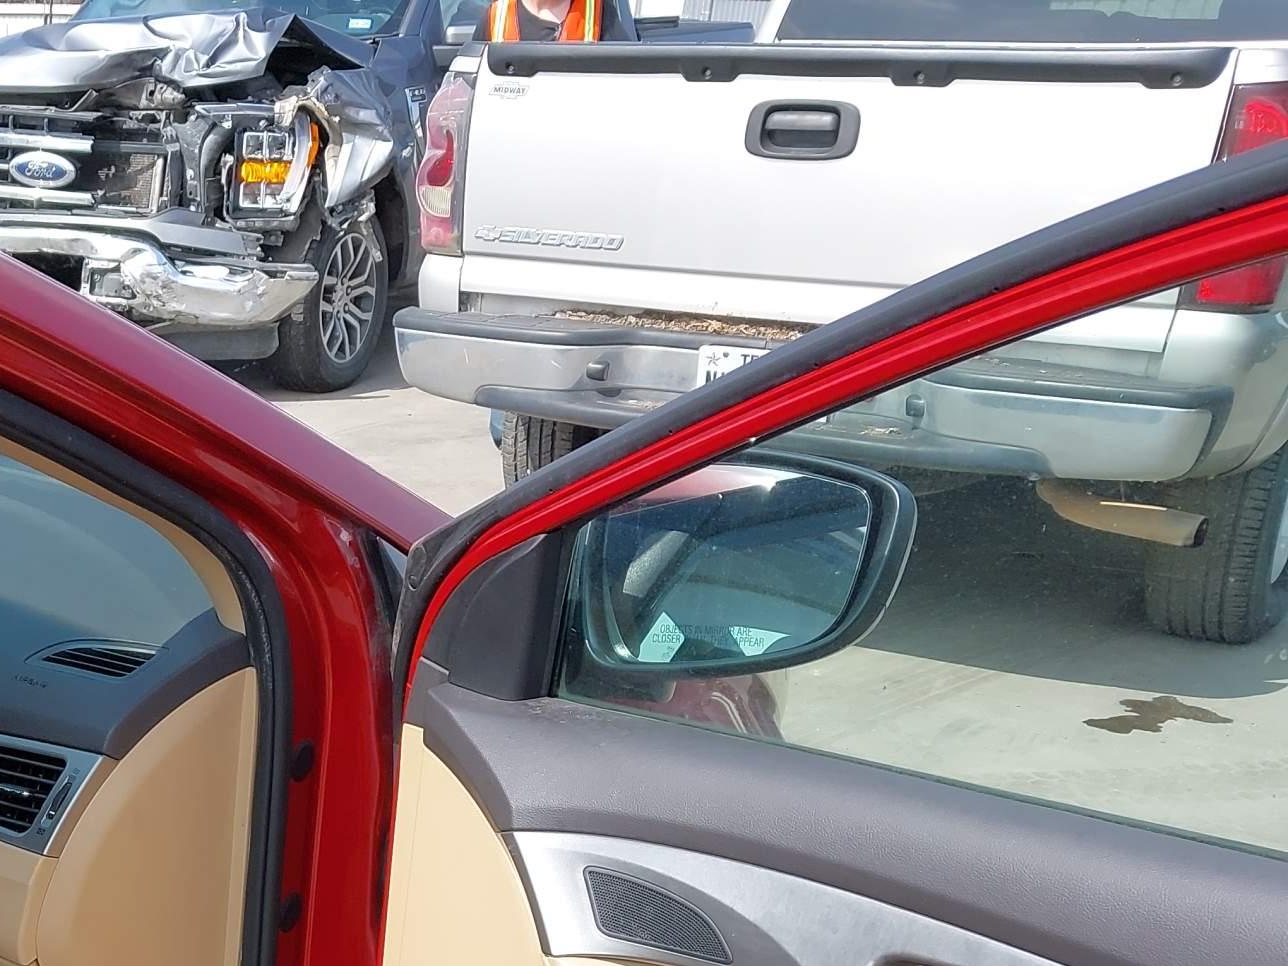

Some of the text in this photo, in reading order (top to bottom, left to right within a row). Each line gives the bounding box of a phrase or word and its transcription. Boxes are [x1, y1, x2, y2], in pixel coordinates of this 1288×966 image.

[492, 86, 527, 95] MIDWAY
[25, 160, 56, 178] Ford
[498, 227, 625, 251] SILVERADO
[736, 626, 753, 637] ARE
[652, 633, 681, 645] CLOSER
